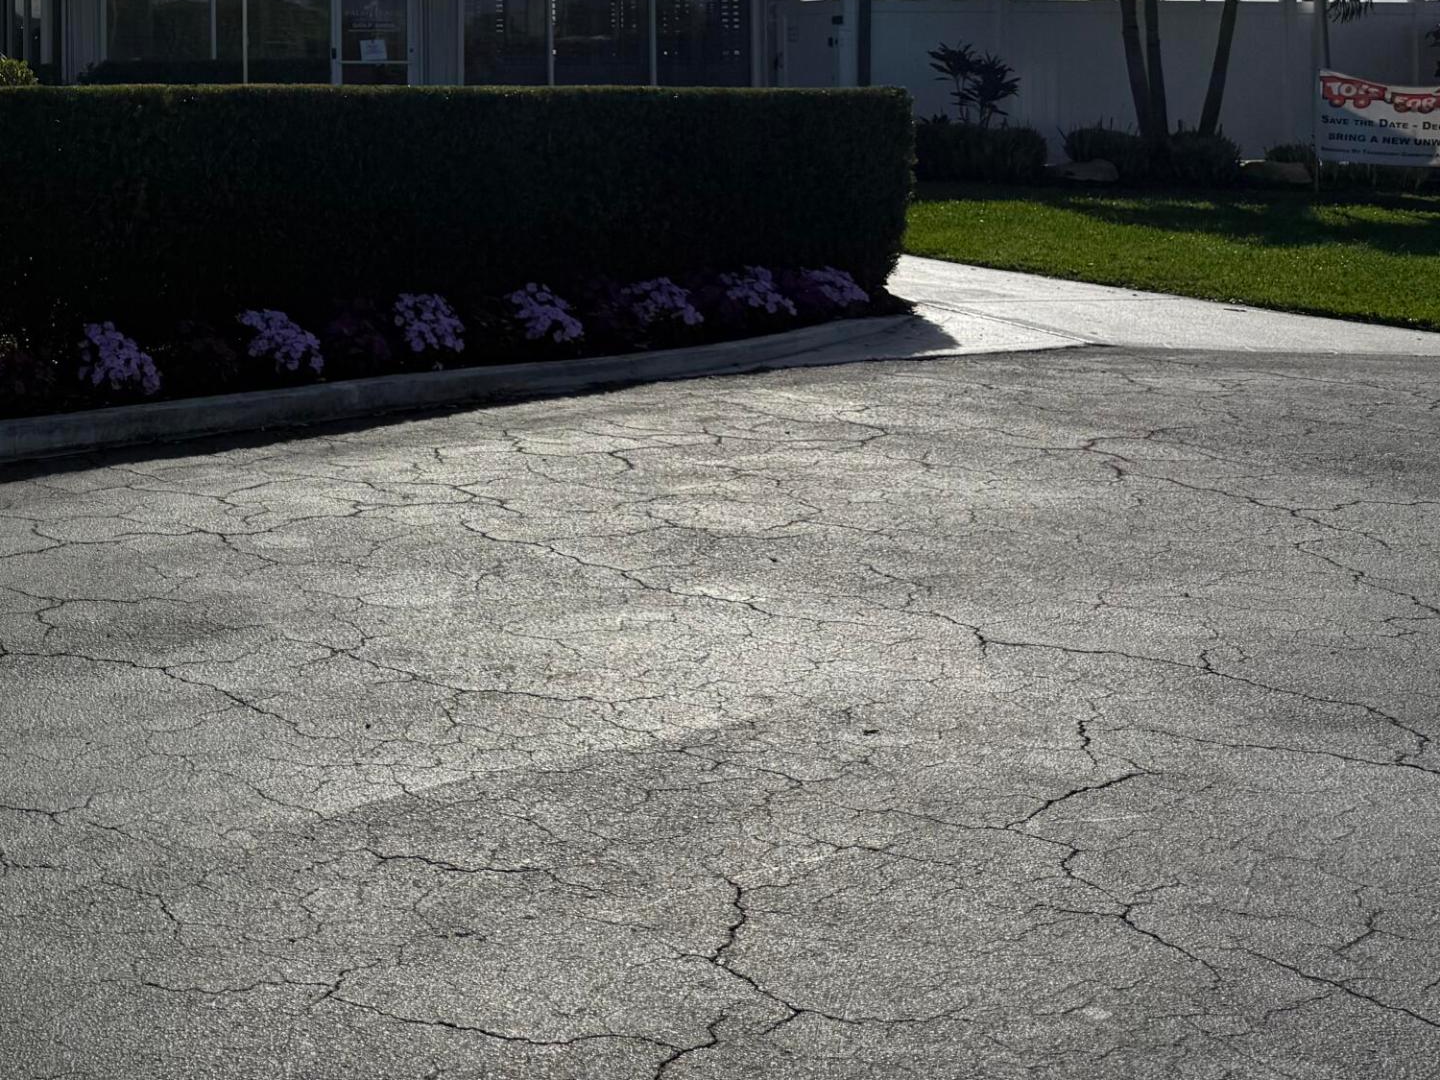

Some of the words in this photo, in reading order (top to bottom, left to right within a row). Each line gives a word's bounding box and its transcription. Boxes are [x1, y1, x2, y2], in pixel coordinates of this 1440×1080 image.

[1328, 132, 1367, 143] BRING
[1370, 136, 1378, 144] A
[1382, 136, 1410, 145] NEW
